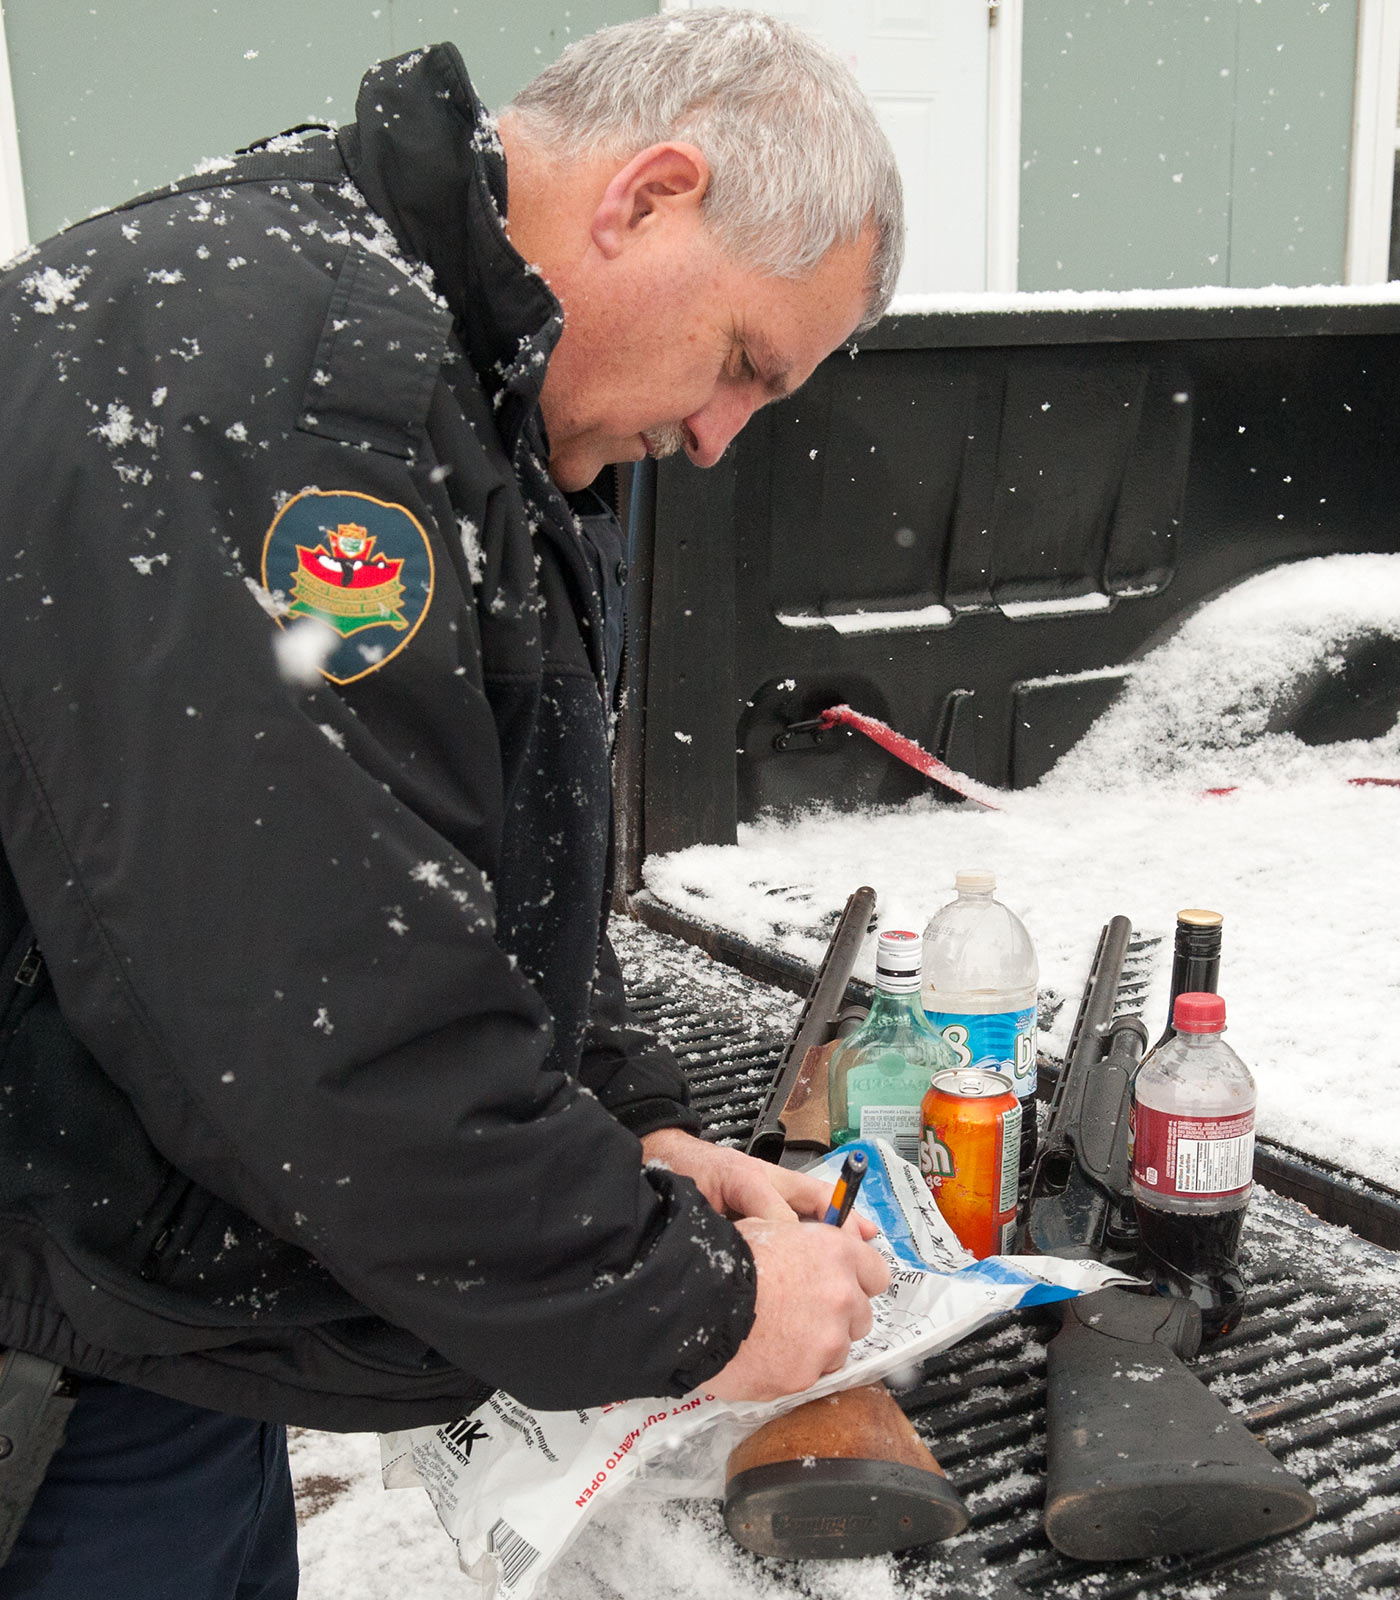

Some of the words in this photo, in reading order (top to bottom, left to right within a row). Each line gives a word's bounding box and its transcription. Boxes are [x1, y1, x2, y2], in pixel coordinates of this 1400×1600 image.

[671, 1398, 702, 1416] NOT
[642, 1411, 668, 1432] CUT
[445, 1441, 471, 1467] SAFETY
[605, 1450, 624, 1470] TO
[575, 1471, 607, 1508] OPEN
